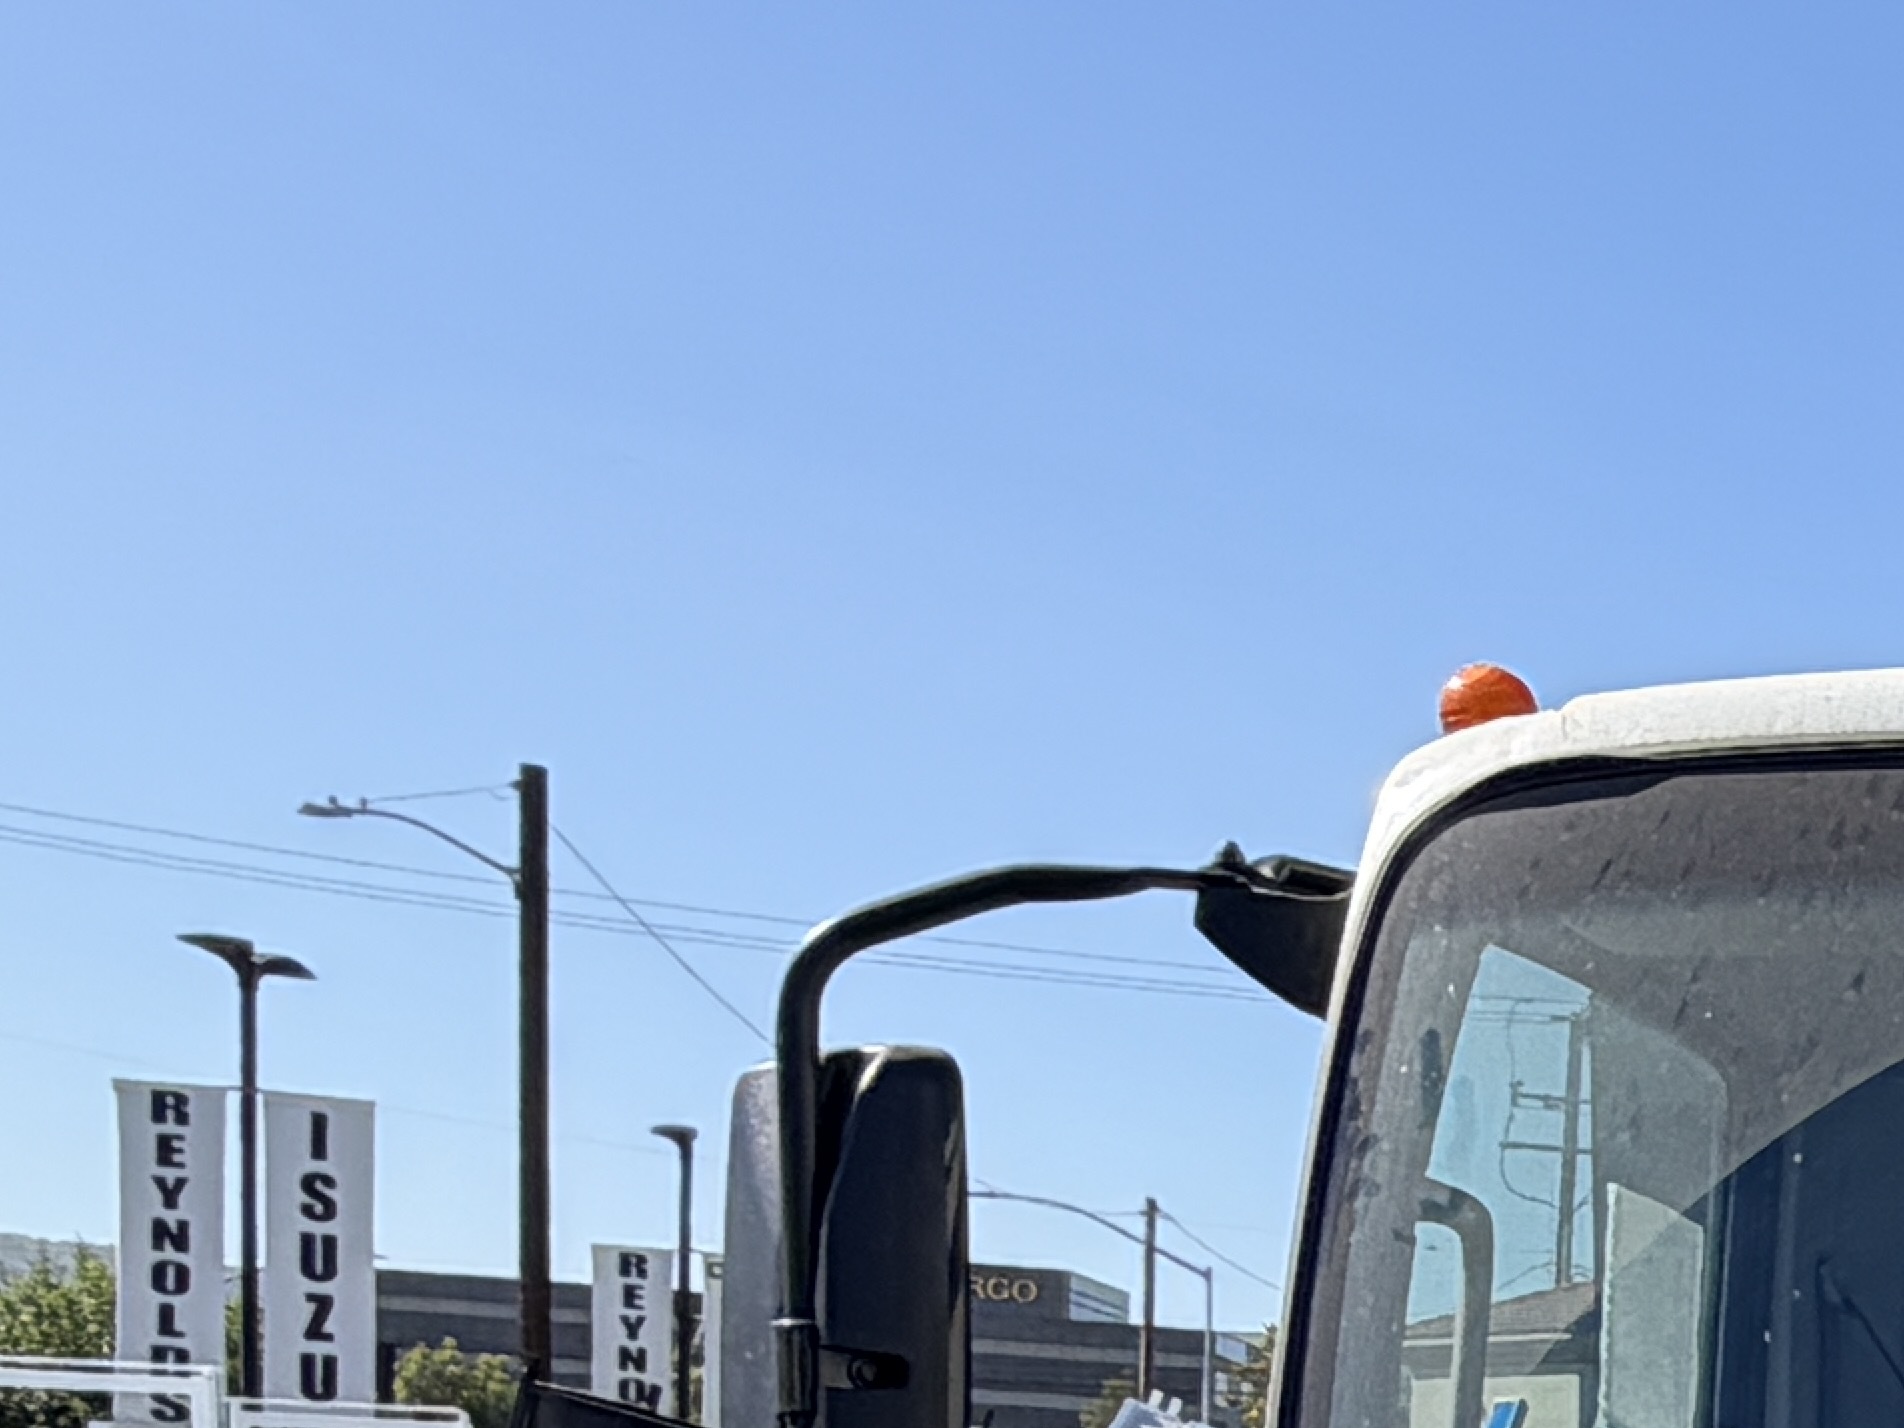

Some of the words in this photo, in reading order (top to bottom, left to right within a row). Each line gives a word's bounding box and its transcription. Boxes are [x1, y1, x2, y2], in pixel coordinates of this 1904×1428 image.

[299, 1109, 339, 1400] ISUZU
[617, 1251, 649, 1404] REYNO
[970, 1276, 1038, 1303] RGO
